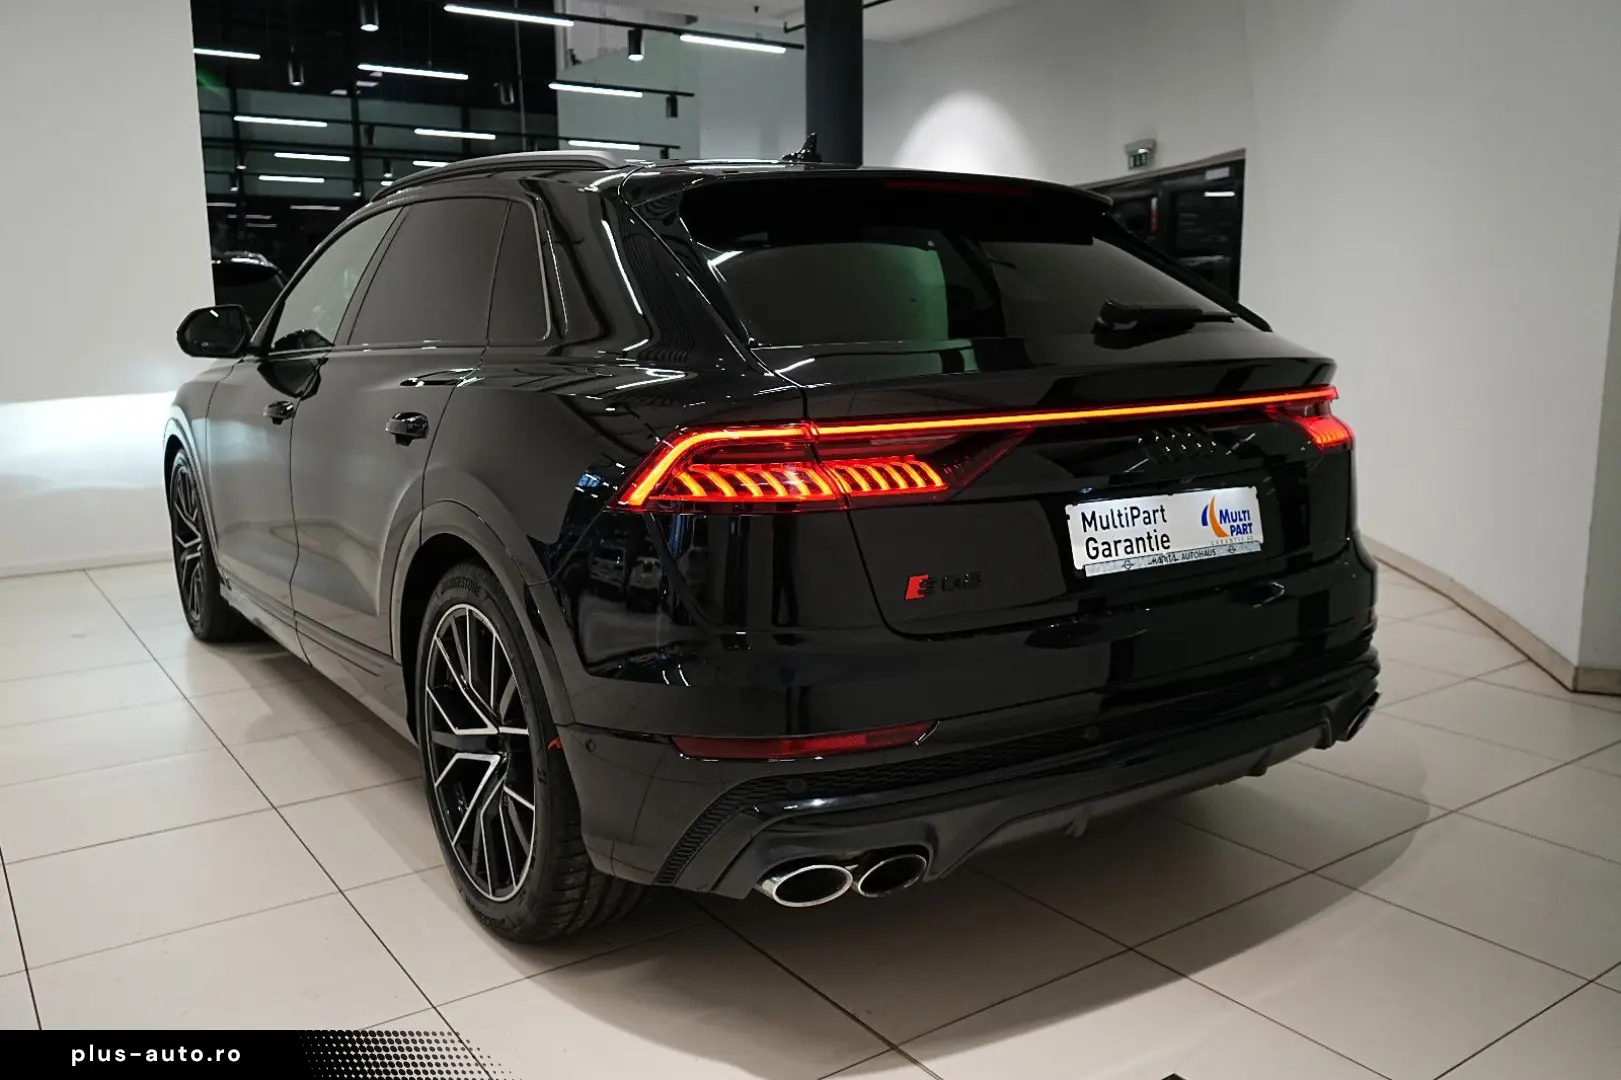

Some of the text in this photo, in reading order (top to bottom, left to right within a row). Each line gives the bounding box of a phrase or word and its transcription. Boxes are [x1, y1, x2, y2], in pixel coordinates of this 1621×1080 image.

[1080, 504, 1168, 533] MultiPart
[1219, 508, 1251, 525] MULTI
[1229, 522, 1253, 537] PART
[1085, 530, 1171, 560] Garantie
[1181, 548, 1217, 562] AUTOHAUS
